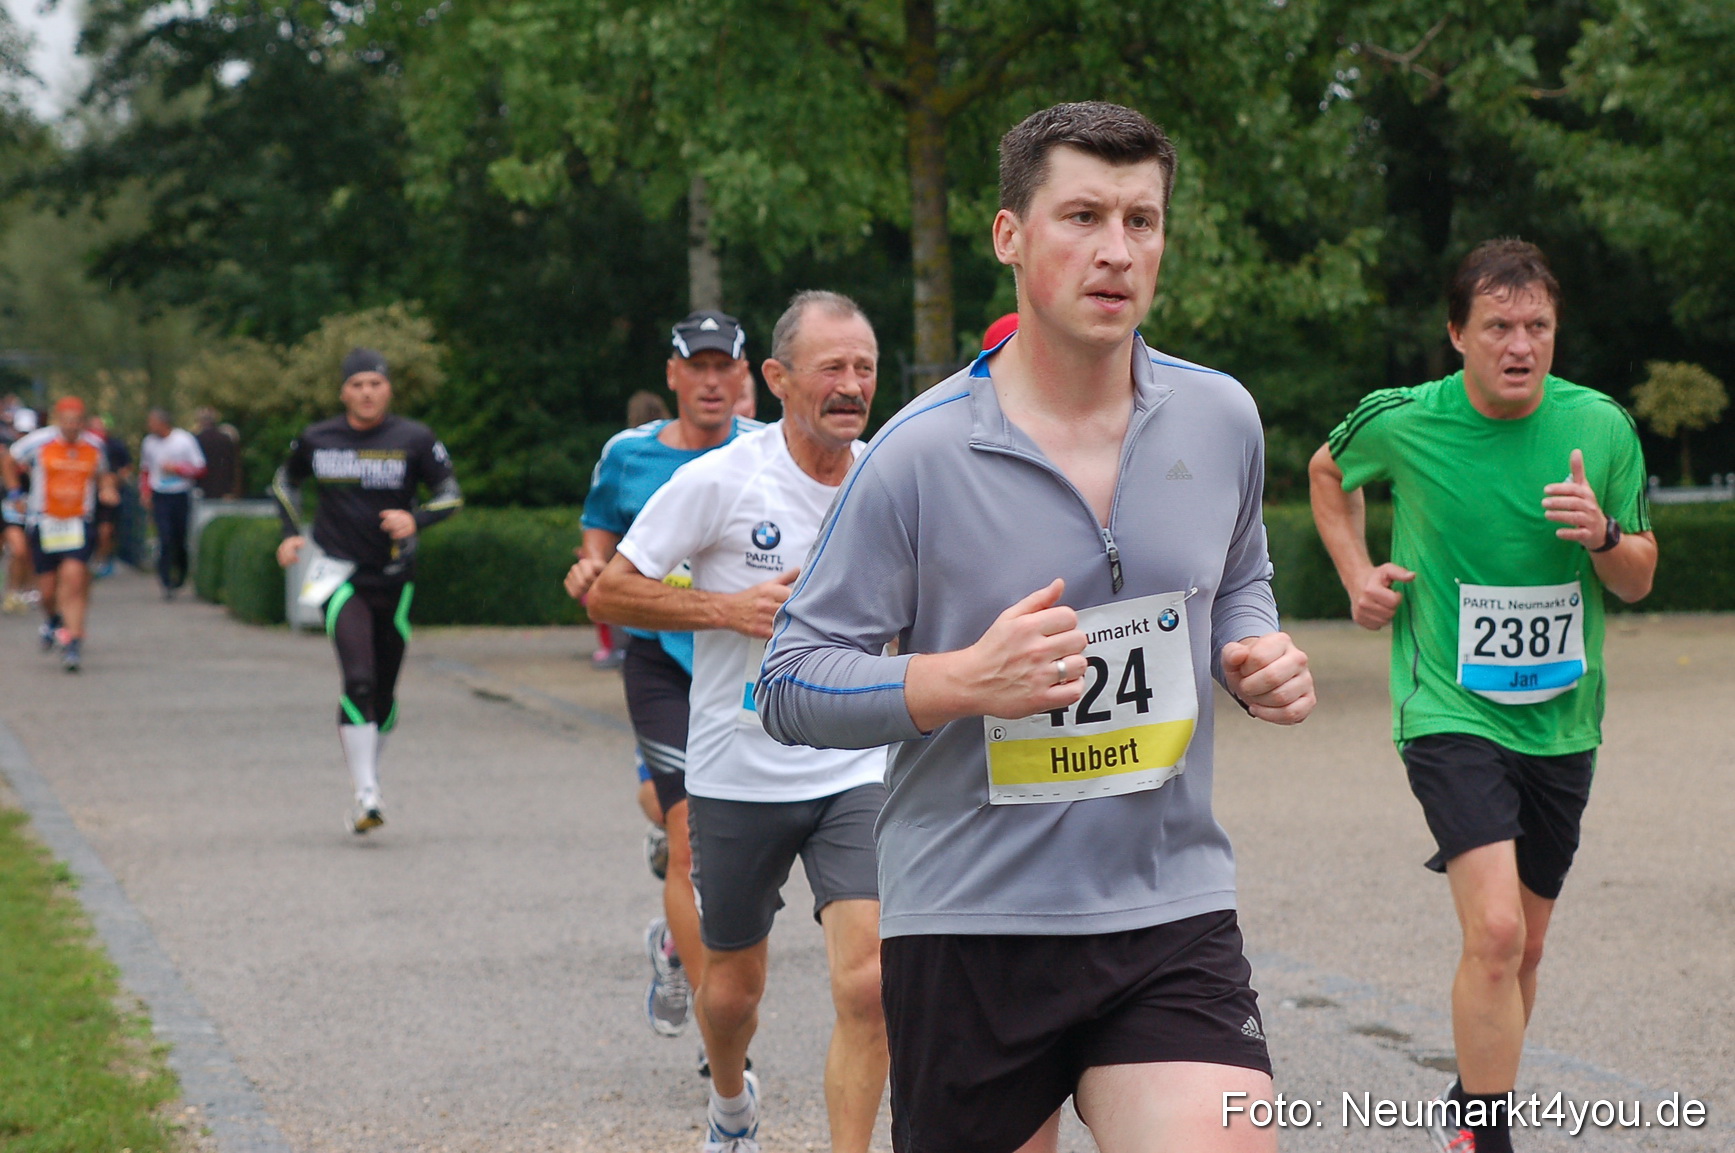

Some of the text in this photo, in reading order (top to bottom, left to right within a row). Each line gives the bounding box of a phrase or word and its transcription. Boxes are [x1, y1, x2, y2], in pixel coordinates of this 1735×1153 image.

[746, 551, 783, 565] PARTL
[1463, 597, 1565, 610] PARTL Neumarkt
[1085, 618, 1151, 645] umarkt
[1474, 613, 1573, 659] 2387
[1509, 671, 1538, 688] Jan
[1051, 738, 1140, 774] Hubert
